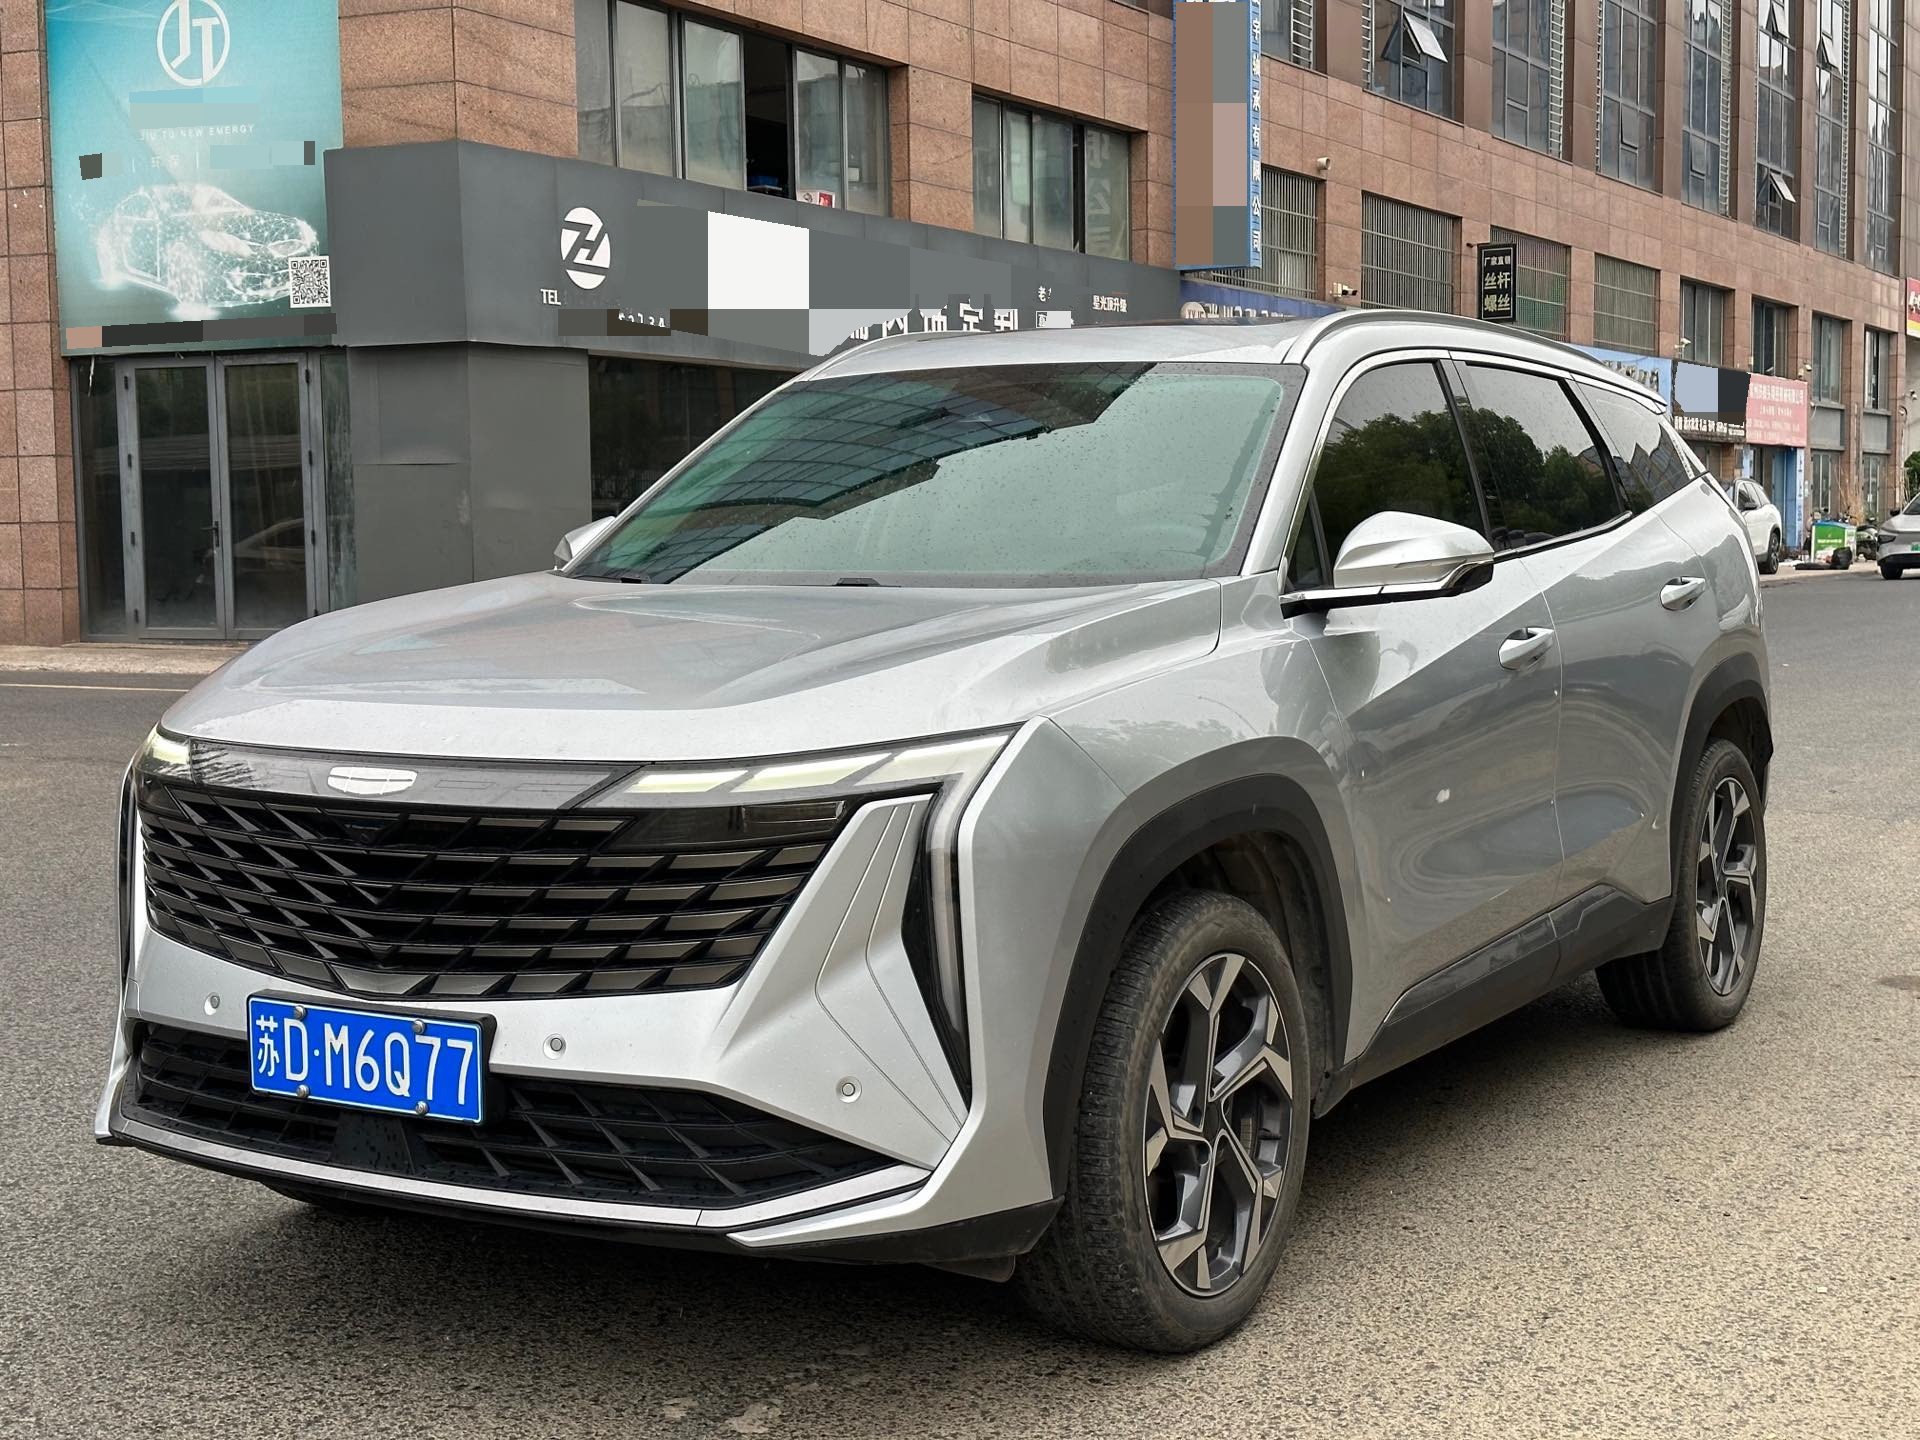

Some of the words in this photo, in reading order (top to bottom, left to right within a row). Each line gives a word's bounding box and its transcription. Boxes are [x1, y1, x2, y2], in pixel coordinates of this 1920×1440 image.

[1484, 272, 1511, 290] 丝杆
[540, 288, 561, 306] TEL
[1092, 295, 1128, 313] 星光顶升级
[1484, 294, 1511, 312] 螺丝
[256, 1015, 474, 1105] 苏D·M6Q77
